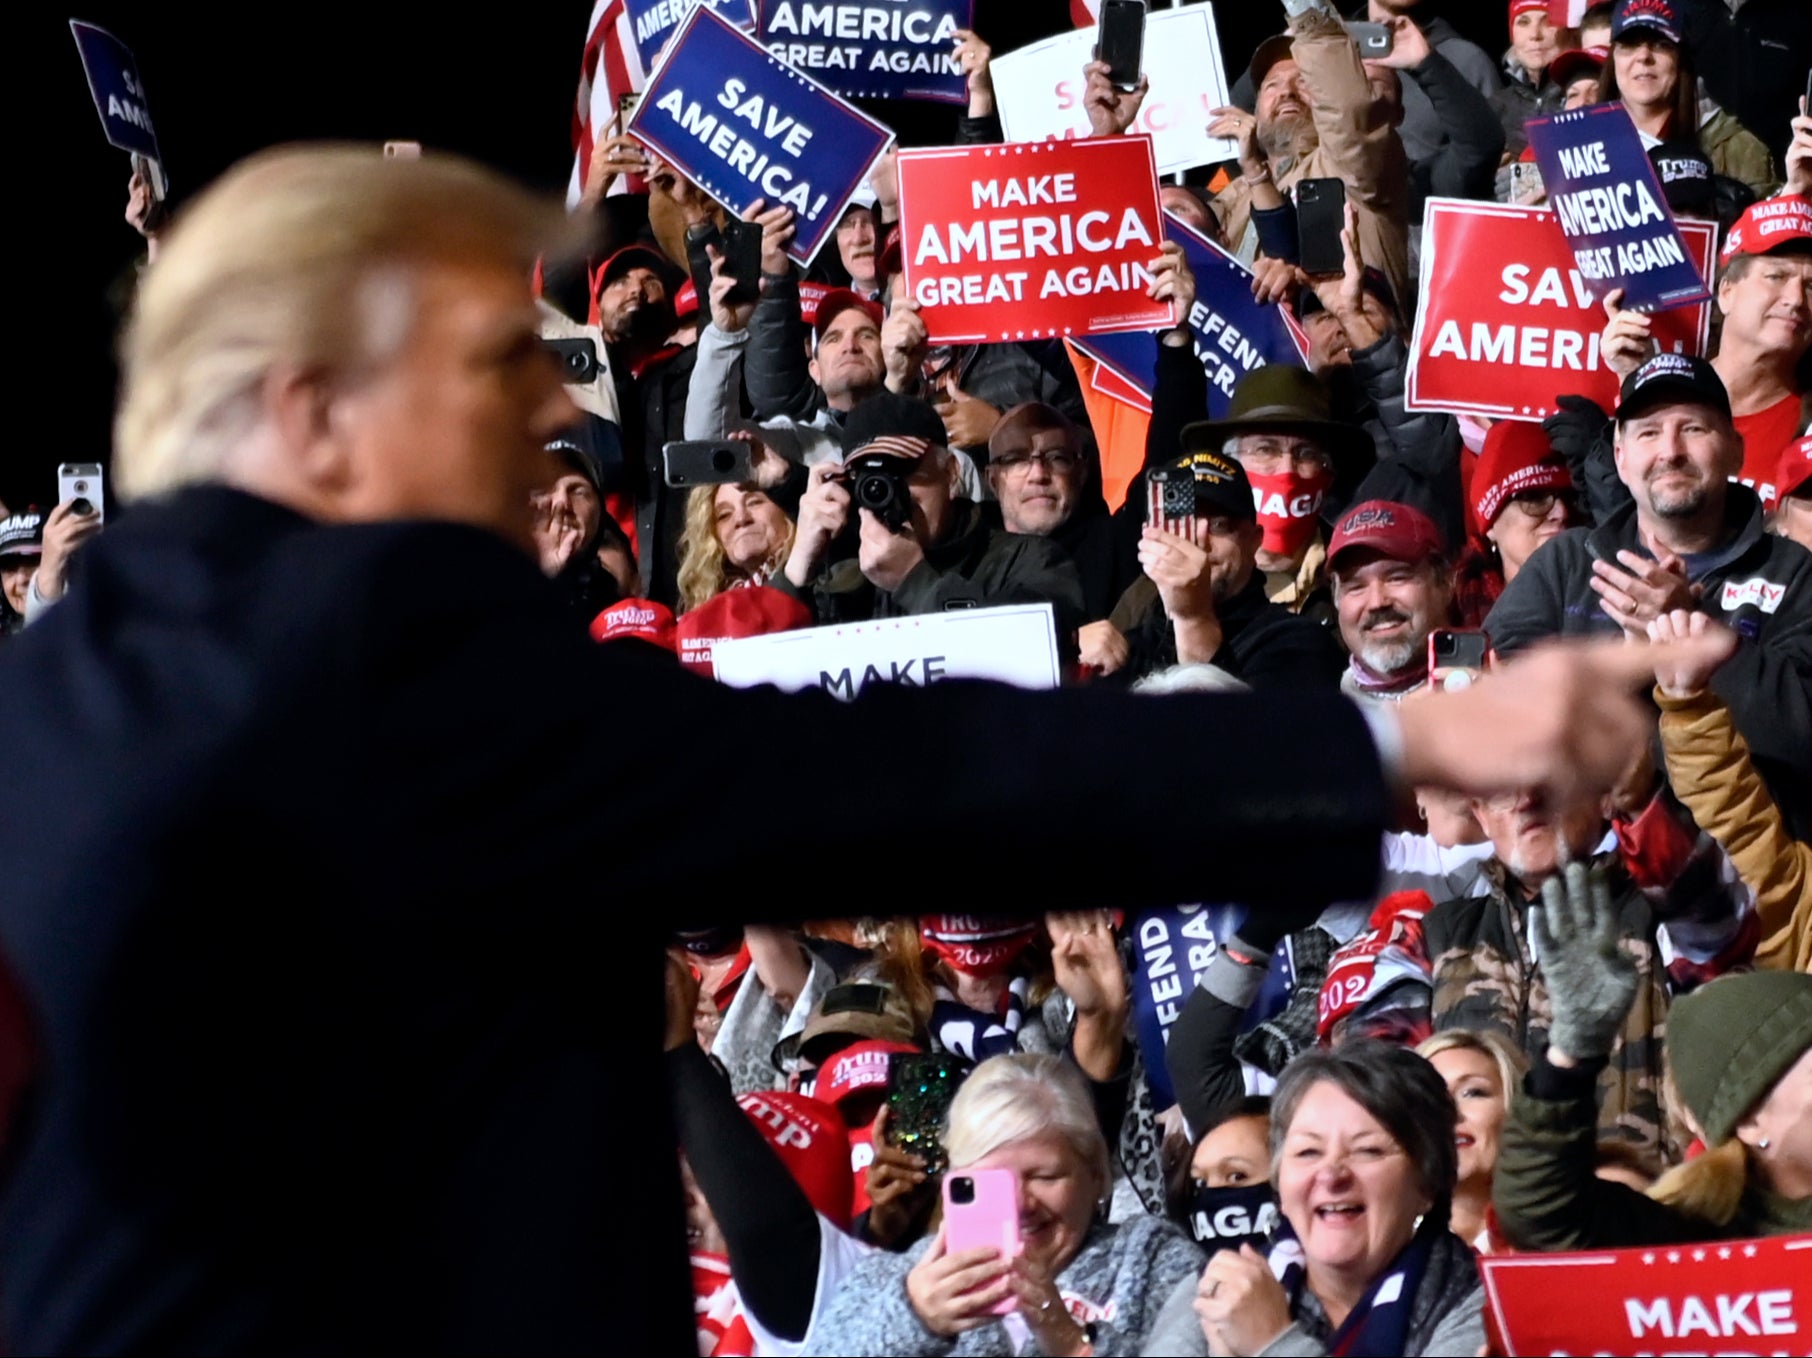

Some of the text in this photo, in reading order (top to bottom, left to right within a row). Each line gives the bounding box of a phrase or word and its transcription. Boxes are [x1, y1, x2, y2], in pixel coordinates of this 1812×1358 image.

[768, 2, 963, 45] AMERICA
[869, 51, 963, 76] AGAIN
[717, 78, 813, 158] SAVE
[656, 88, 828, 221] AMERICA!
[1558, 141, 1610, 180] MAKE
[971, 173, 1077, 210] MAKE
[1555, 179, 1665, 237] AMERICA
[1752, 202, 1787, 222] MAKE
[913, 207, 1154, 266] AMERICA
[1760, 217, 1798, 236] GREAT
[1617, 233, 1685, 277] AGAIN
[915, 260, 1157, 308] GREAT AGAIN
[1193, 453, 1236, 476] NIMITZ
[1501, 464, 1559, 487] AMERICA
[819, 656, 946, 699] MAKE
[1140, 917, 1183, 1046] FEND
[1624, 1290, 1798, 1338] MAKE
